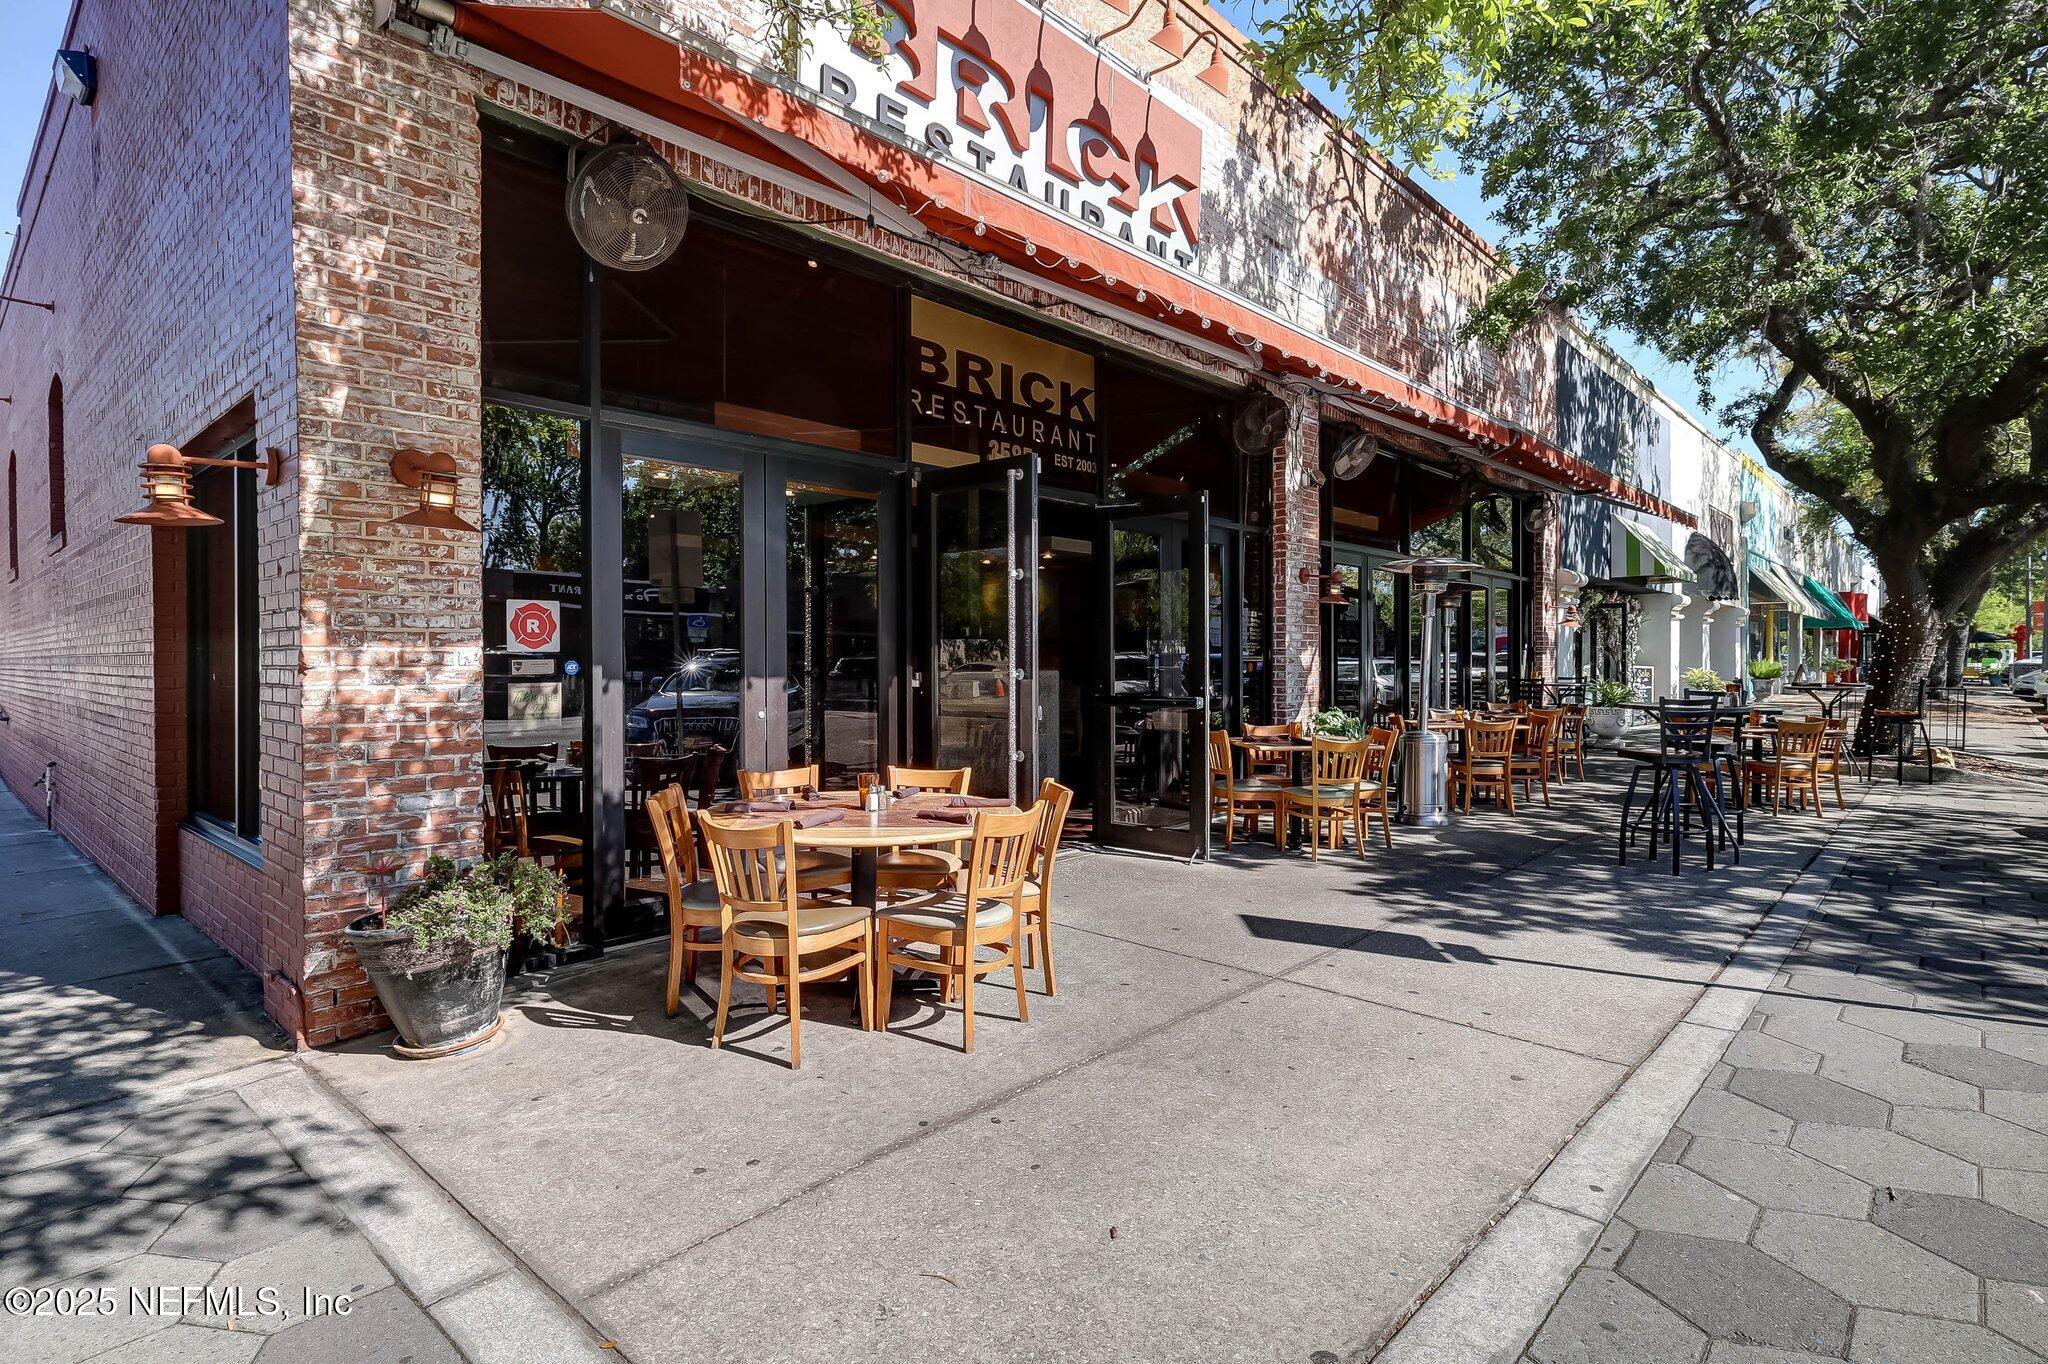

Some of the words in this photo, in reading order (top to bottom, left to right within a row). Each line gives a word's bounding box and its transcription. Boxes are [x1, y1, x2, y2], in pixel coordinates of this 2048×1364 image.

[830, 0, 1200, 252] BRICK
[820, 63, 1194, 270] RESTAURANT
[911, 335, 1096, 422] BRICK
[911, 389, 1096, 454] RESTAURANT
[1054, 453, 1074, 469] EST
[1076, 458, 1097, 474] 2003
[526, 618, 541, 634] R
